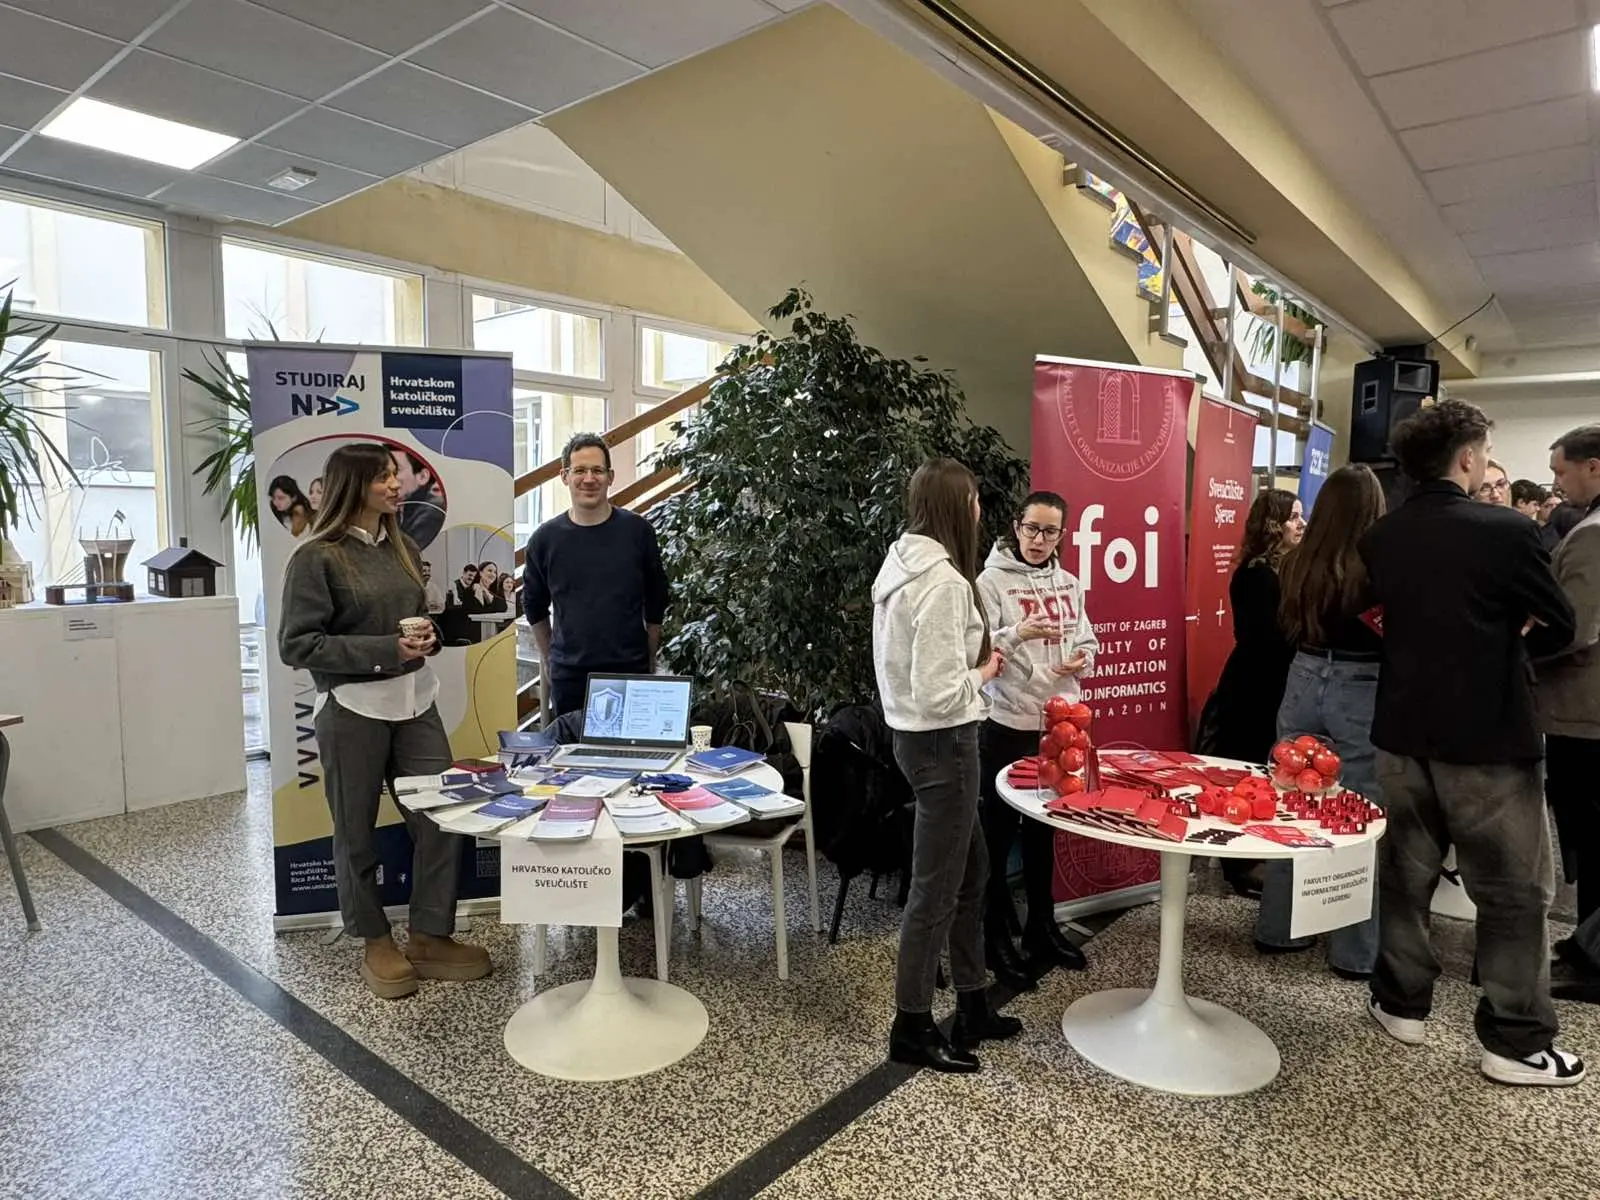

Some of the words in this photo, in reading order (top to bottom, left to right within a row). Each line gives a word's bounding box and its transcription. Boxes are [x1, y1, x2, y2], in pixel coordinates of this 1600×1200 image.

[275, 371, 366, 392] STUDIRAJ
[390, 375, 455, 389] Hrvatskom
[390, 390, 456, 403] katoličkom
[391, 405, 456, 417] sveučilištu
[1077, 437, 1140, 474] ORGANIZACIJE
[1072, 503, 1159, 590] foi
[1091, 622, 1117, 633] RSITY
[1119, 621, 1131, 632] OF
[1134, 619, 1167, 631] ZAGREB
[1097, 640, 1132, 655] ULTY
[1148, 638, 1167, 651] OF
[1095, 659, 1167, 678] ANIZATION
[1080, 688, 1092, 702] ND
[1094, 681, 1167, 700] INFORMATICS
[1094, 701, 1167, 718] RAŽDIN
[511, 865, 559, 874] HRVATSKO
[561, 865, 612, 876] KATOLIČKO
[535, 878, 588, 889] SVEUČILIŠTE
